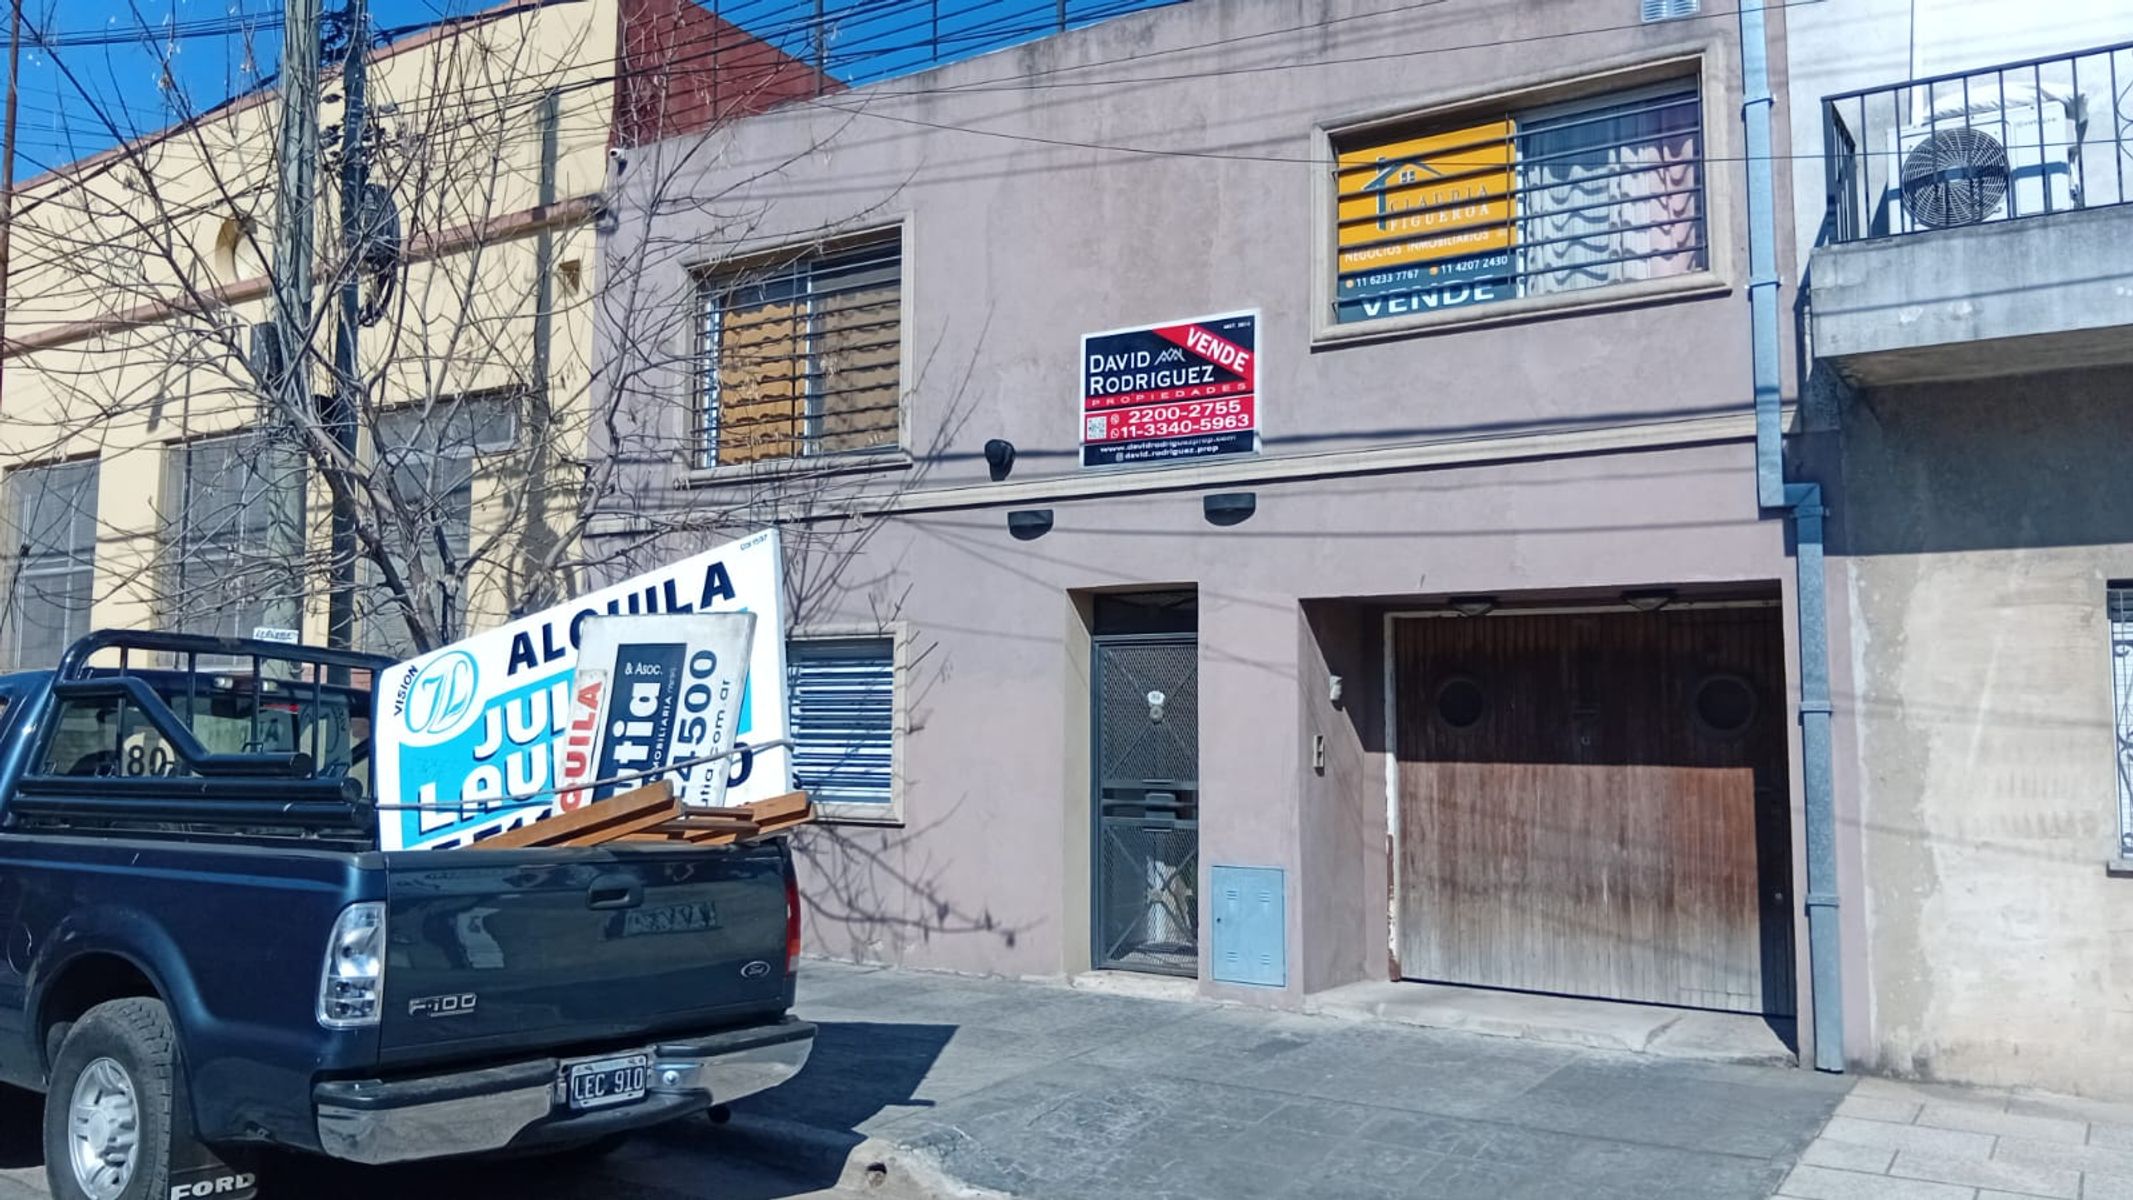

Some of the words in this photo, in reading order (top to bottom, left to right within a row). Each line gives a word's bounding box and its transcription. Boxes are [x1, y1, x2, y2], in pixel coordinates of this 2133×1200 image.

[1390, 203, 1490, 232] FIGUEROA
[1356, 277, 1367, 288] 11
[1441, 264, 1452, 275] 11
[1359, 274, 1495, 317] VENDE
[1089, 351, 1151, 374] DAVID
[1186, 327, 1249, 372] VENDE
[1089, 365, 1215, 396] RODRIGUEZ
[1092, 382, 1247, 406] PROPIEDADES
[1120, 414, 1250, 439] 11-3340-5963
[1128, 400, 1241, 424] 2200-2755
[507, 561, 736, 676] ALILA
[393, 664, 419, 717] VISION
[649, 696, 673, 783] NMOBILIARIA
[574, 1073, 606, 1100] LEC
[614, 1066, 645, 1094] 910
[170, 1172, 256, 1200] FORD
